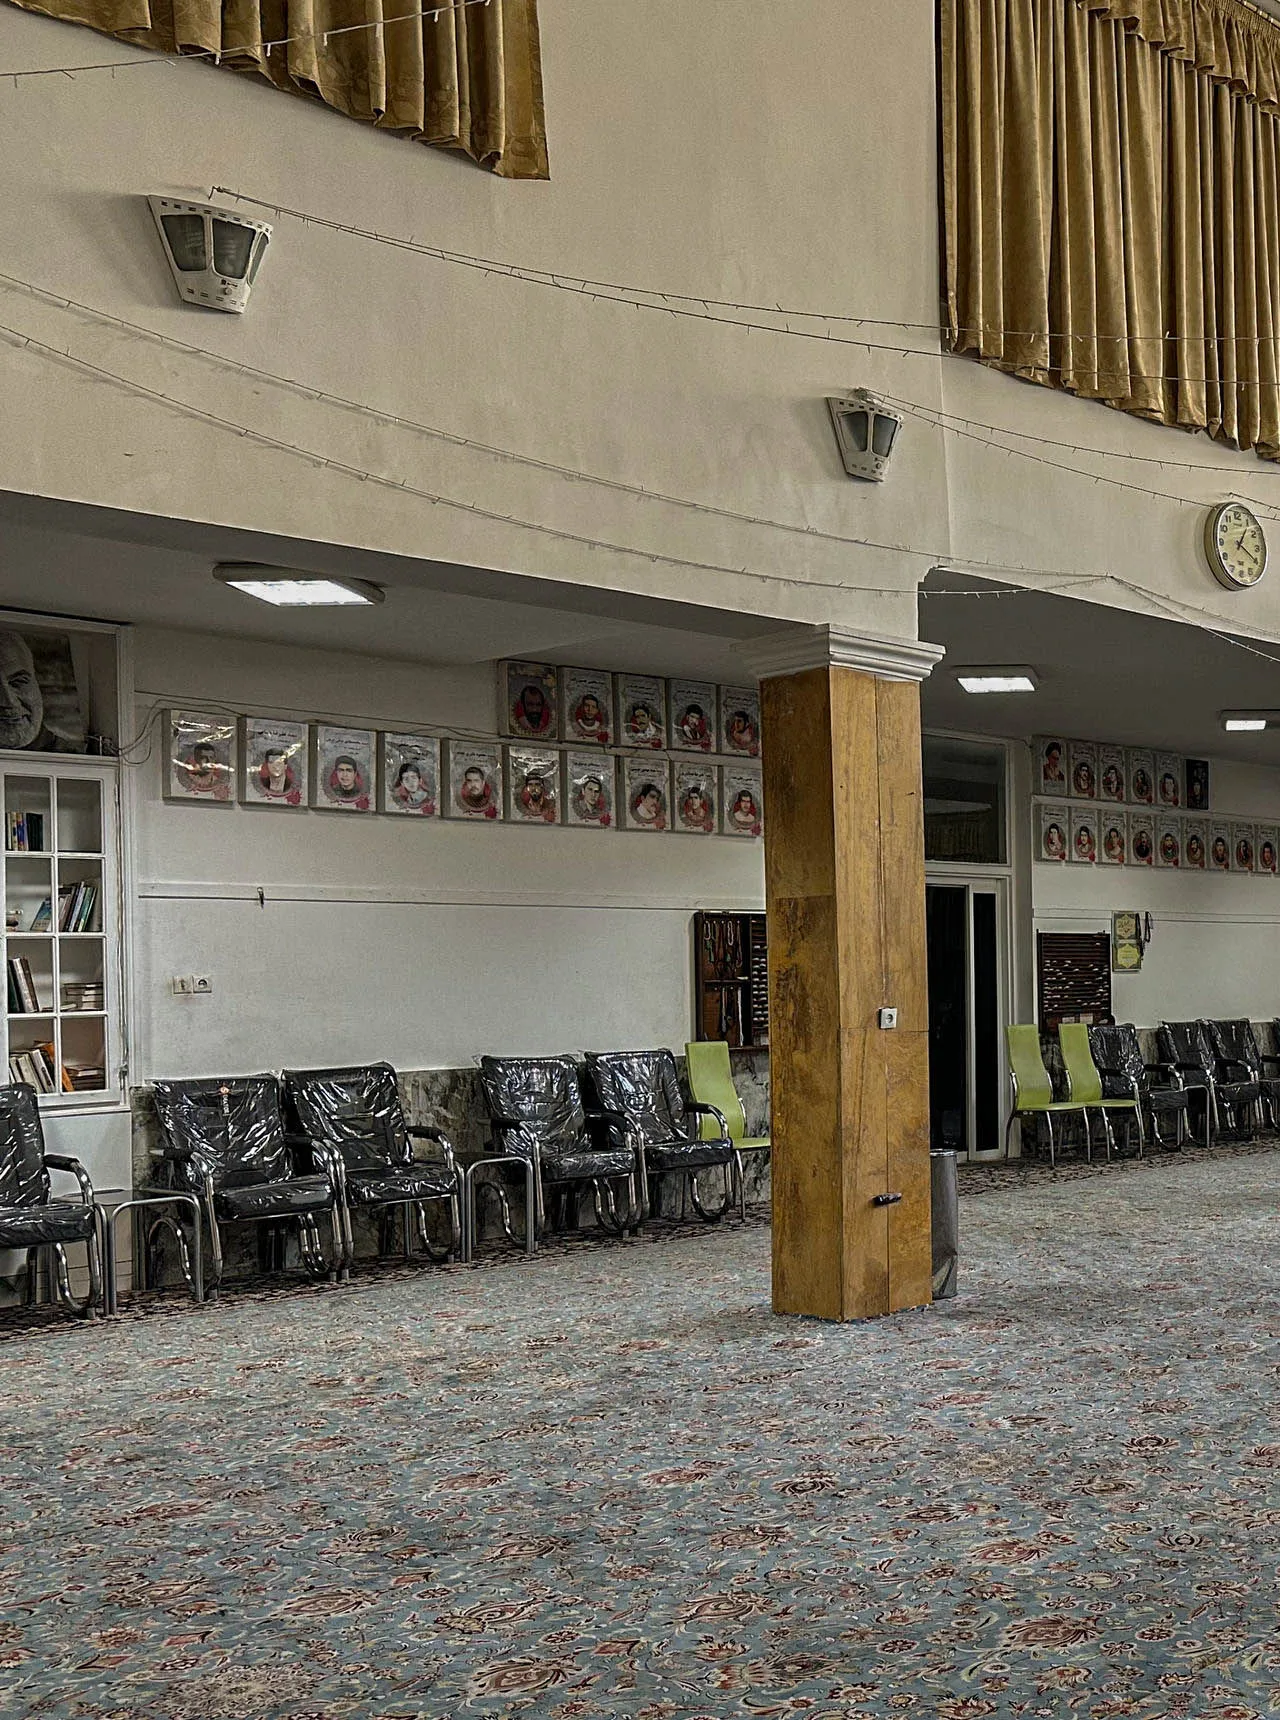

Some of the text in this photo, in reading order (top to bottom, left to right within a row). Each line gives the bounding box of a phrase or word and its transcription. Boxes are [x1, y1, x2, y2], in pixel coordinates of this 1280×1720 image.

[1225, 515, 1232, 523] 11
[1234, 511, 1242, 521] 12
[1246, 519, 1249, 527] 1
[1220, 525, 1228, 533] 10
[1251, 530, 1257, 539] 2
[1219, 538, 1224, 546] 9
[1255, 545, 1260, 553] 3
[1229, 565, 1235, 573] 7
